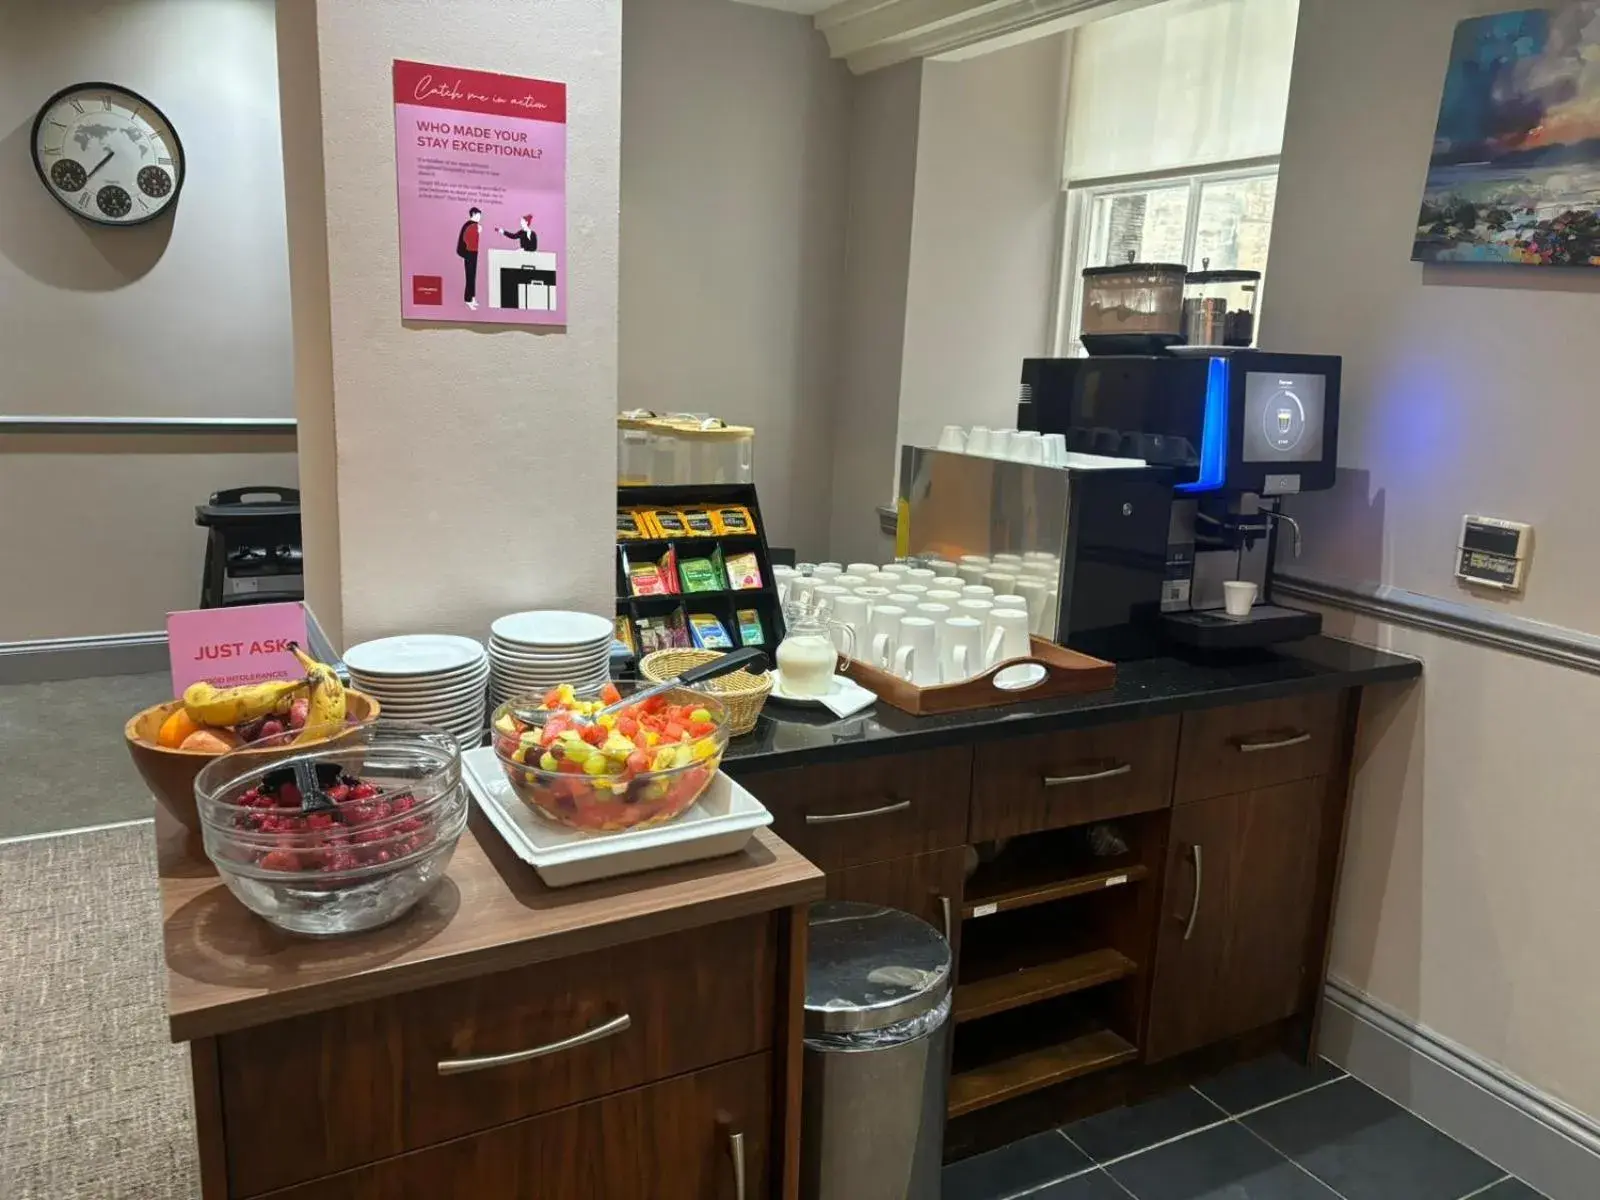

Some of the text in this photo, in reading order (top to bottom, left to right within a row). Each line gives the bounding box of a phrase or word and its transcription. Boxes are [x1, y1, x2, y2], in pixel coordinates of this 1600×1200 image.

[414, 75, 548, 111] Catch me in action
[416, 120, 528, 143] WHO MADE YOUR
[417, 136, 543, 159] STAY EXCEPTIONAL?
[194, 638, 288, 661] JUST ASK
[226, 670, 289, 683] INTOLERANCES
